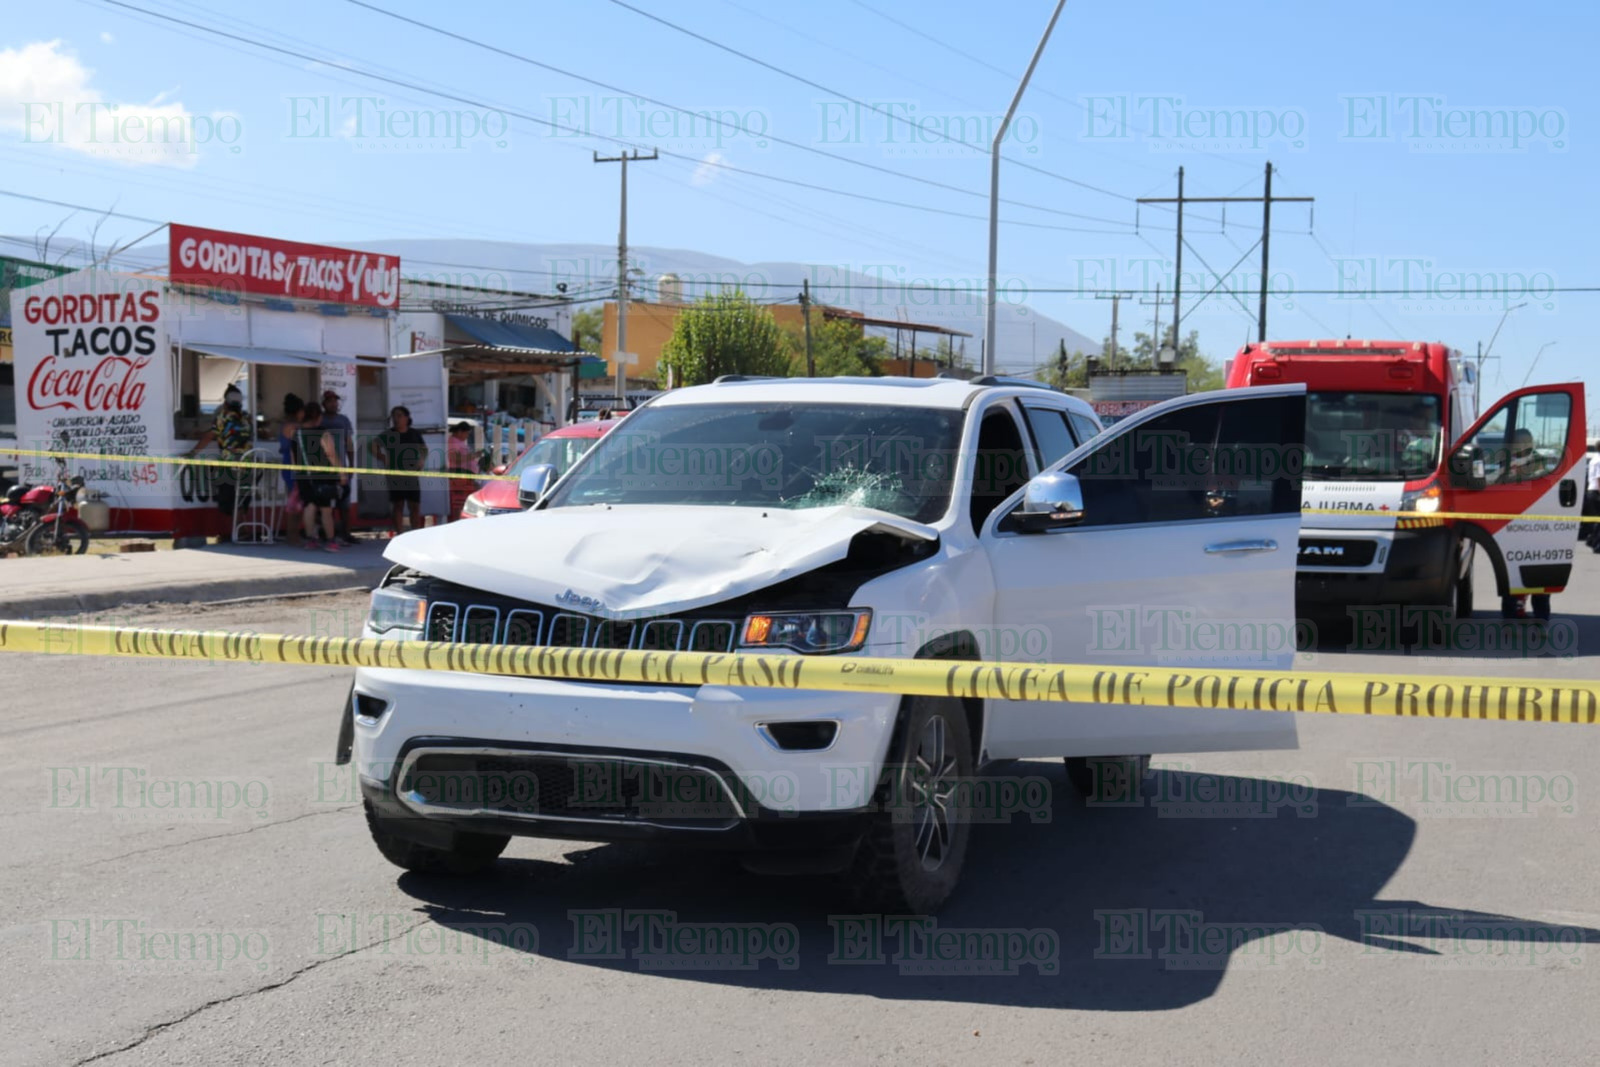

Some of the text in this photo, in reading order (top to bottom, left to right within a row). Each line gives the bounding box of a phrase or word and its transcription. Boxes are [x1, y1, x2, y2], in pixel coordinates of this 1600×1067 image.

[179, 238, 286, 281] GORDITAS
[284, 261, 296, 293] y
[298, 256, 345, 292] TACOS
[24, 291, 160, 325] GORDITAS
[45, 325, 157, 356] TACOS
[108, 413, 141, 426] ASADO
[132, 463, 159, 486] $45
[1297, 546, 1345, 556] AM
[1506, 549, 1574, 562] COAH-097B
[945, 663, 1071, 703] LINEA
[1092, 670, 1150, 706] DE
[1166, 672, 1338, 714] POLICIA
